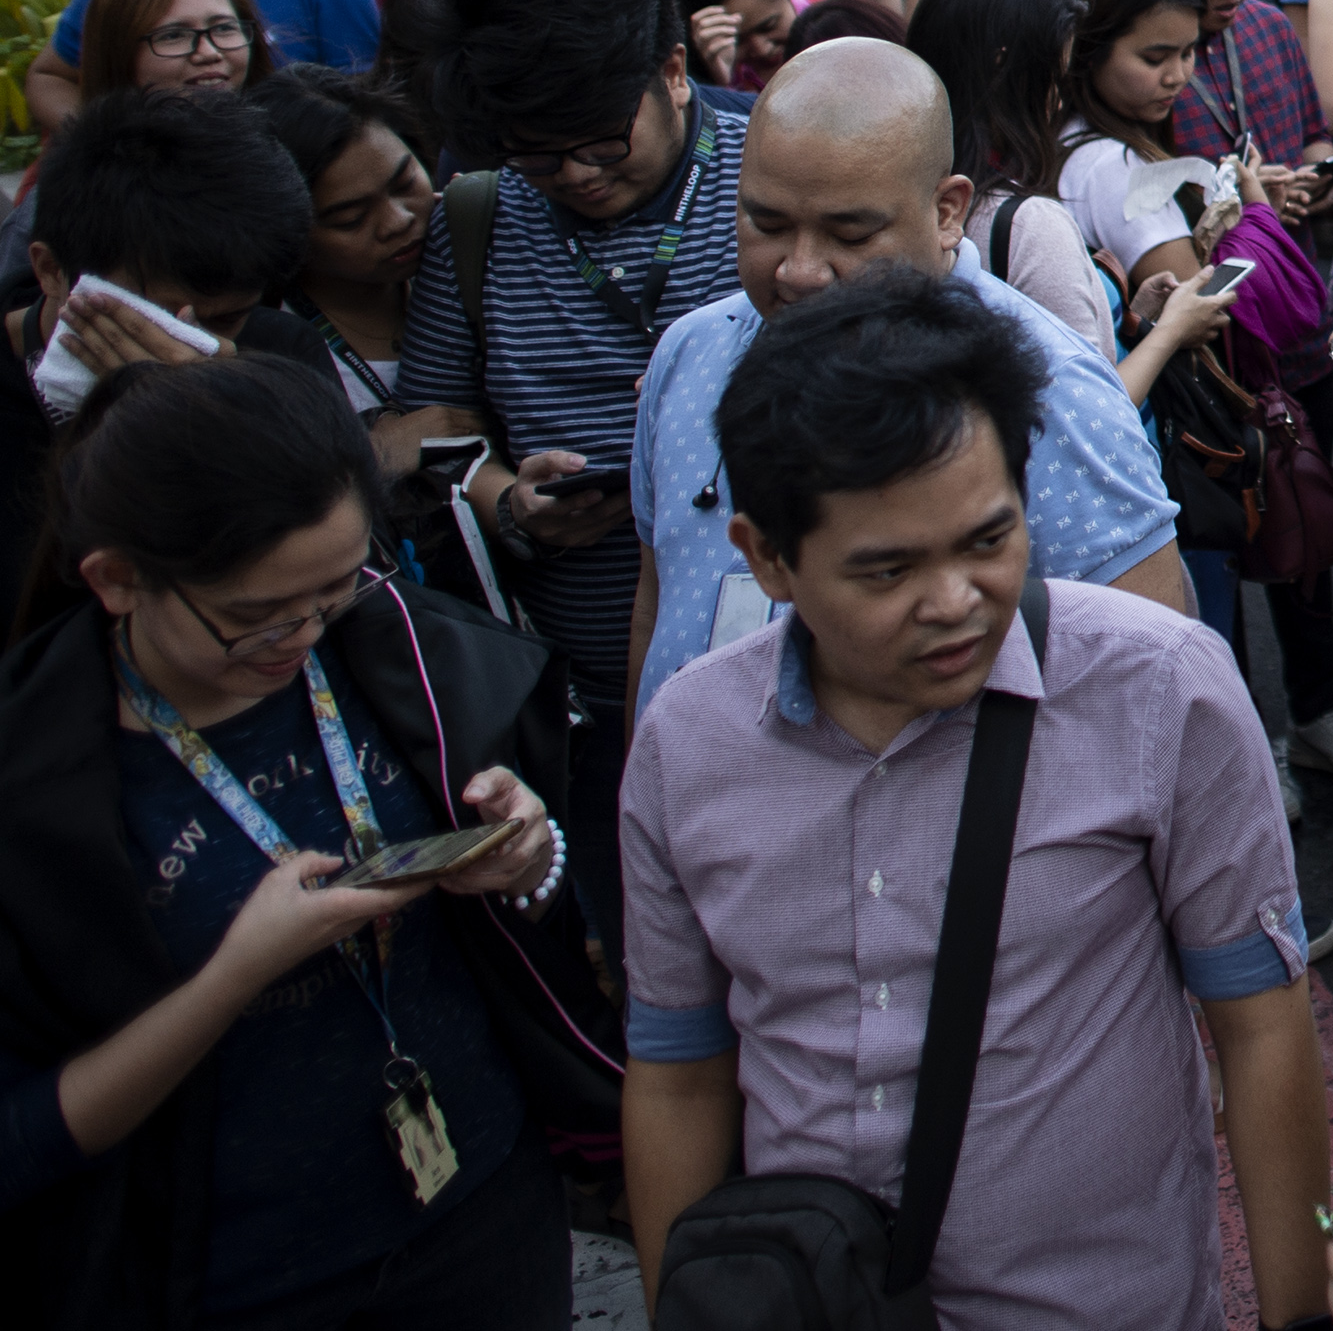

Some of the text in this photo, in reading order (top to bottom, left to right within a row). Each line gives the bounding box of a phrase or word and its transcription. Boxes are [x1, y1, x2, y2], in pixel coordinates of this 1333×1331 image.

[674, 164, 702, 222] #INTHELOOP
[344, 351, 389, 399] #INTHELOOP
[247, 753, 315, 797] ork
[356, 739, 401, 787] ity
